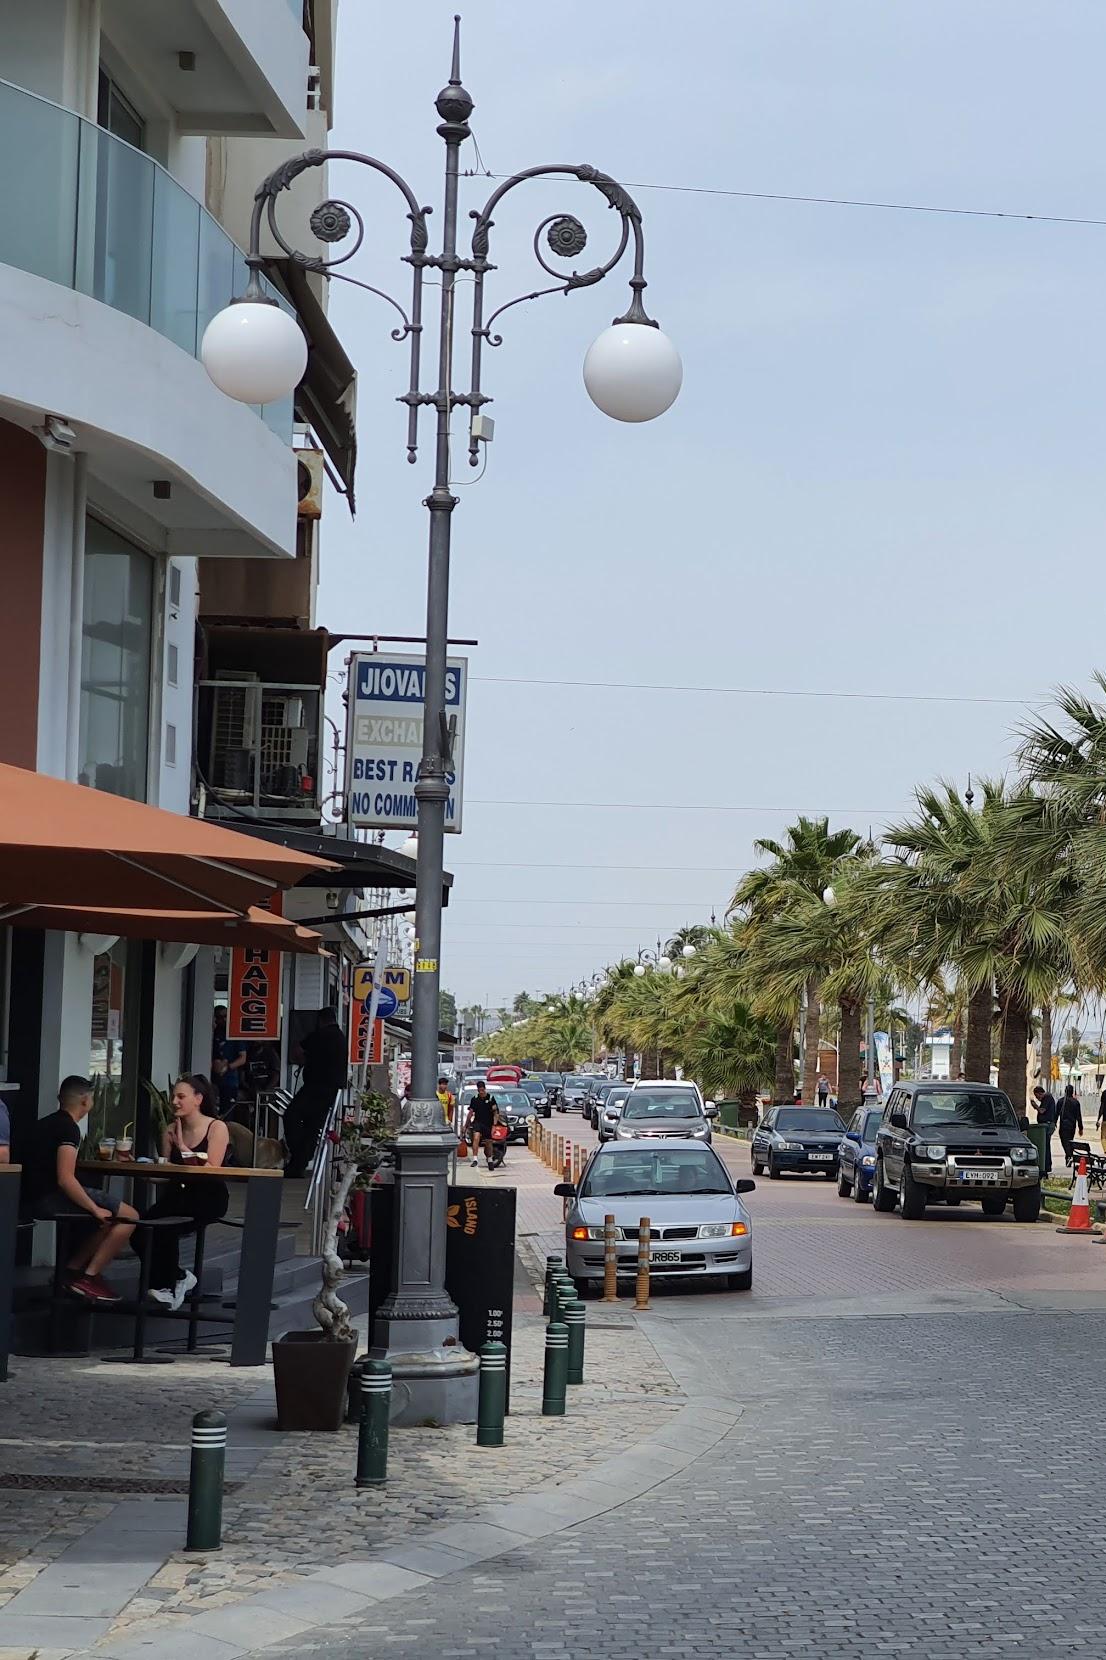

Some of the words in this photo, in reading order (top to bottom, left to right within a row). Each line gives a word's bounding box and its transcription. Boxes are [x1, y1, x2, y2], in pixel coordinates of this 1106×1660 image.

[361, 667, 456, 700] JIOVAS
[359, 718, 424, 745] EXCHA
[354, 758, 397, 781] BEST
[352, 792, 370, 815] NO
[374, 793, 455, 819] COMMIN
[361, 971, 404, 985] AM
[464, 1197, 478, 1235] ISLAND
[648, 1251, 680, 1263] JR865
